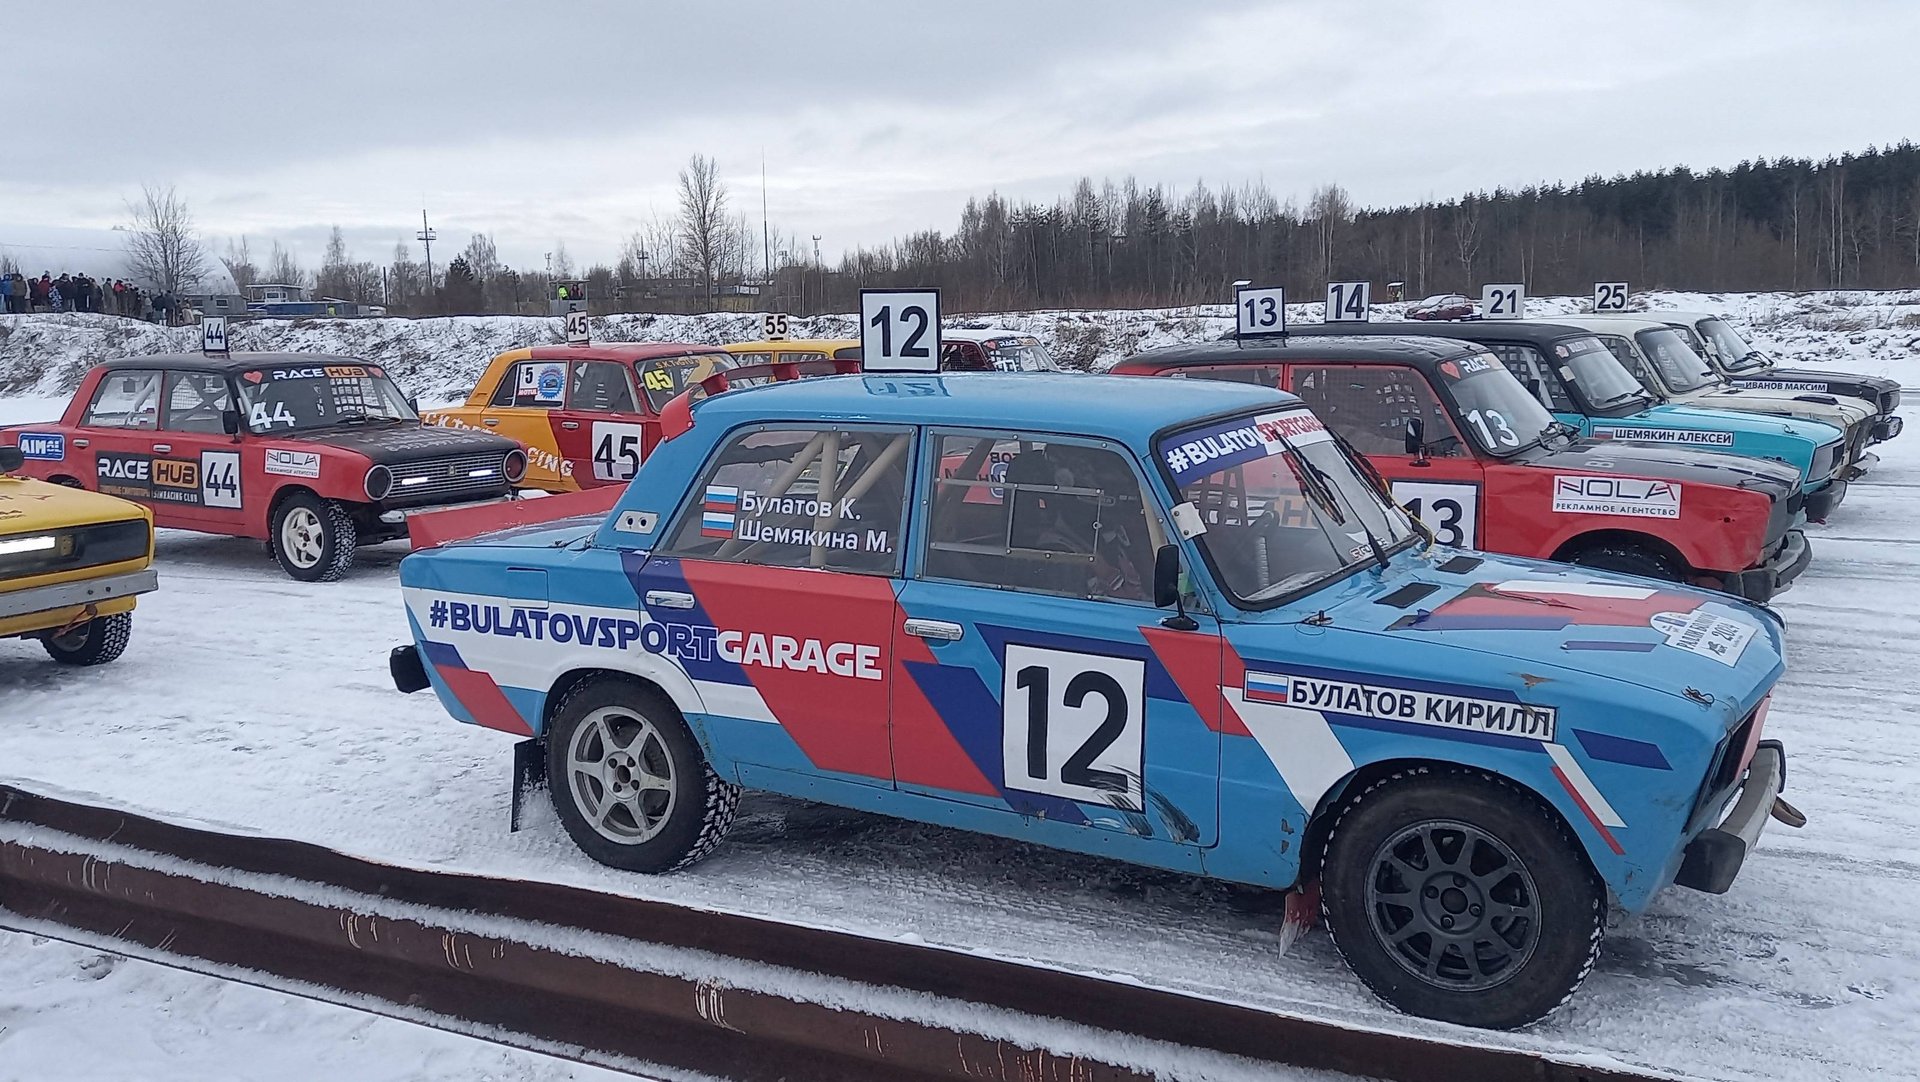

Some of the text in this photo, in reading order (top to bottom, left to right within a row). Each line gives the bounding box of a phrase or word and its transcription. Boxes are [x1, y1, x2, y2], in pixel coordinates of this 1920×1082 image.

[1331, 284, 1365, 319] 14
[1489, 289, 1517, 314] 21
[1597, 285, 1625, 309] 25
[1244, 297, 1278, 327] 13
[205, 323, 224, 343] 44
[568, 316, 587, 335] 45
[765, 315, 788, 335] 55
[871, 305, 929, 357] 12
[273, 367, 364, 380] RACE HUB
[525, 366, 534, 384] 5
[1459, 356, 1490, 374] RACE
[518, 388, 537, 396] MOTUL
[644, 369, 674, 391] 45
[1745, 381, 1826, 391] ИВАНОВ МАКСИМ
[250, 401, 296, 429] 44
[1467, 409, 1520, 449] 13
[1615, 429, 1732, 444] ШЕМЯКИН АЛЕКСЕЙ
[20, 438, 62, 455] AIMOL
[594, 434, 640, 479] 45
[267, 451, 318, 467] NOLA
[98, 459, 195, 484] RACE HUB
[205, 462, 238, 498] 44
[1558, 478, 1676, 501] NOLA
[741, 490, 862, 521] Булатов К.
[1556, 502, 1676, 516] РЕКЛАМНОЕ АГЕНТСТВО
[1403, 498, 1464, 549] 13
[738, 519, 893, 553] Шемякина М.
[1291, 680, 1553, 738] БУЛАТОВ КИРИЛЛ
[1016, 665, 1129, 794] 12
